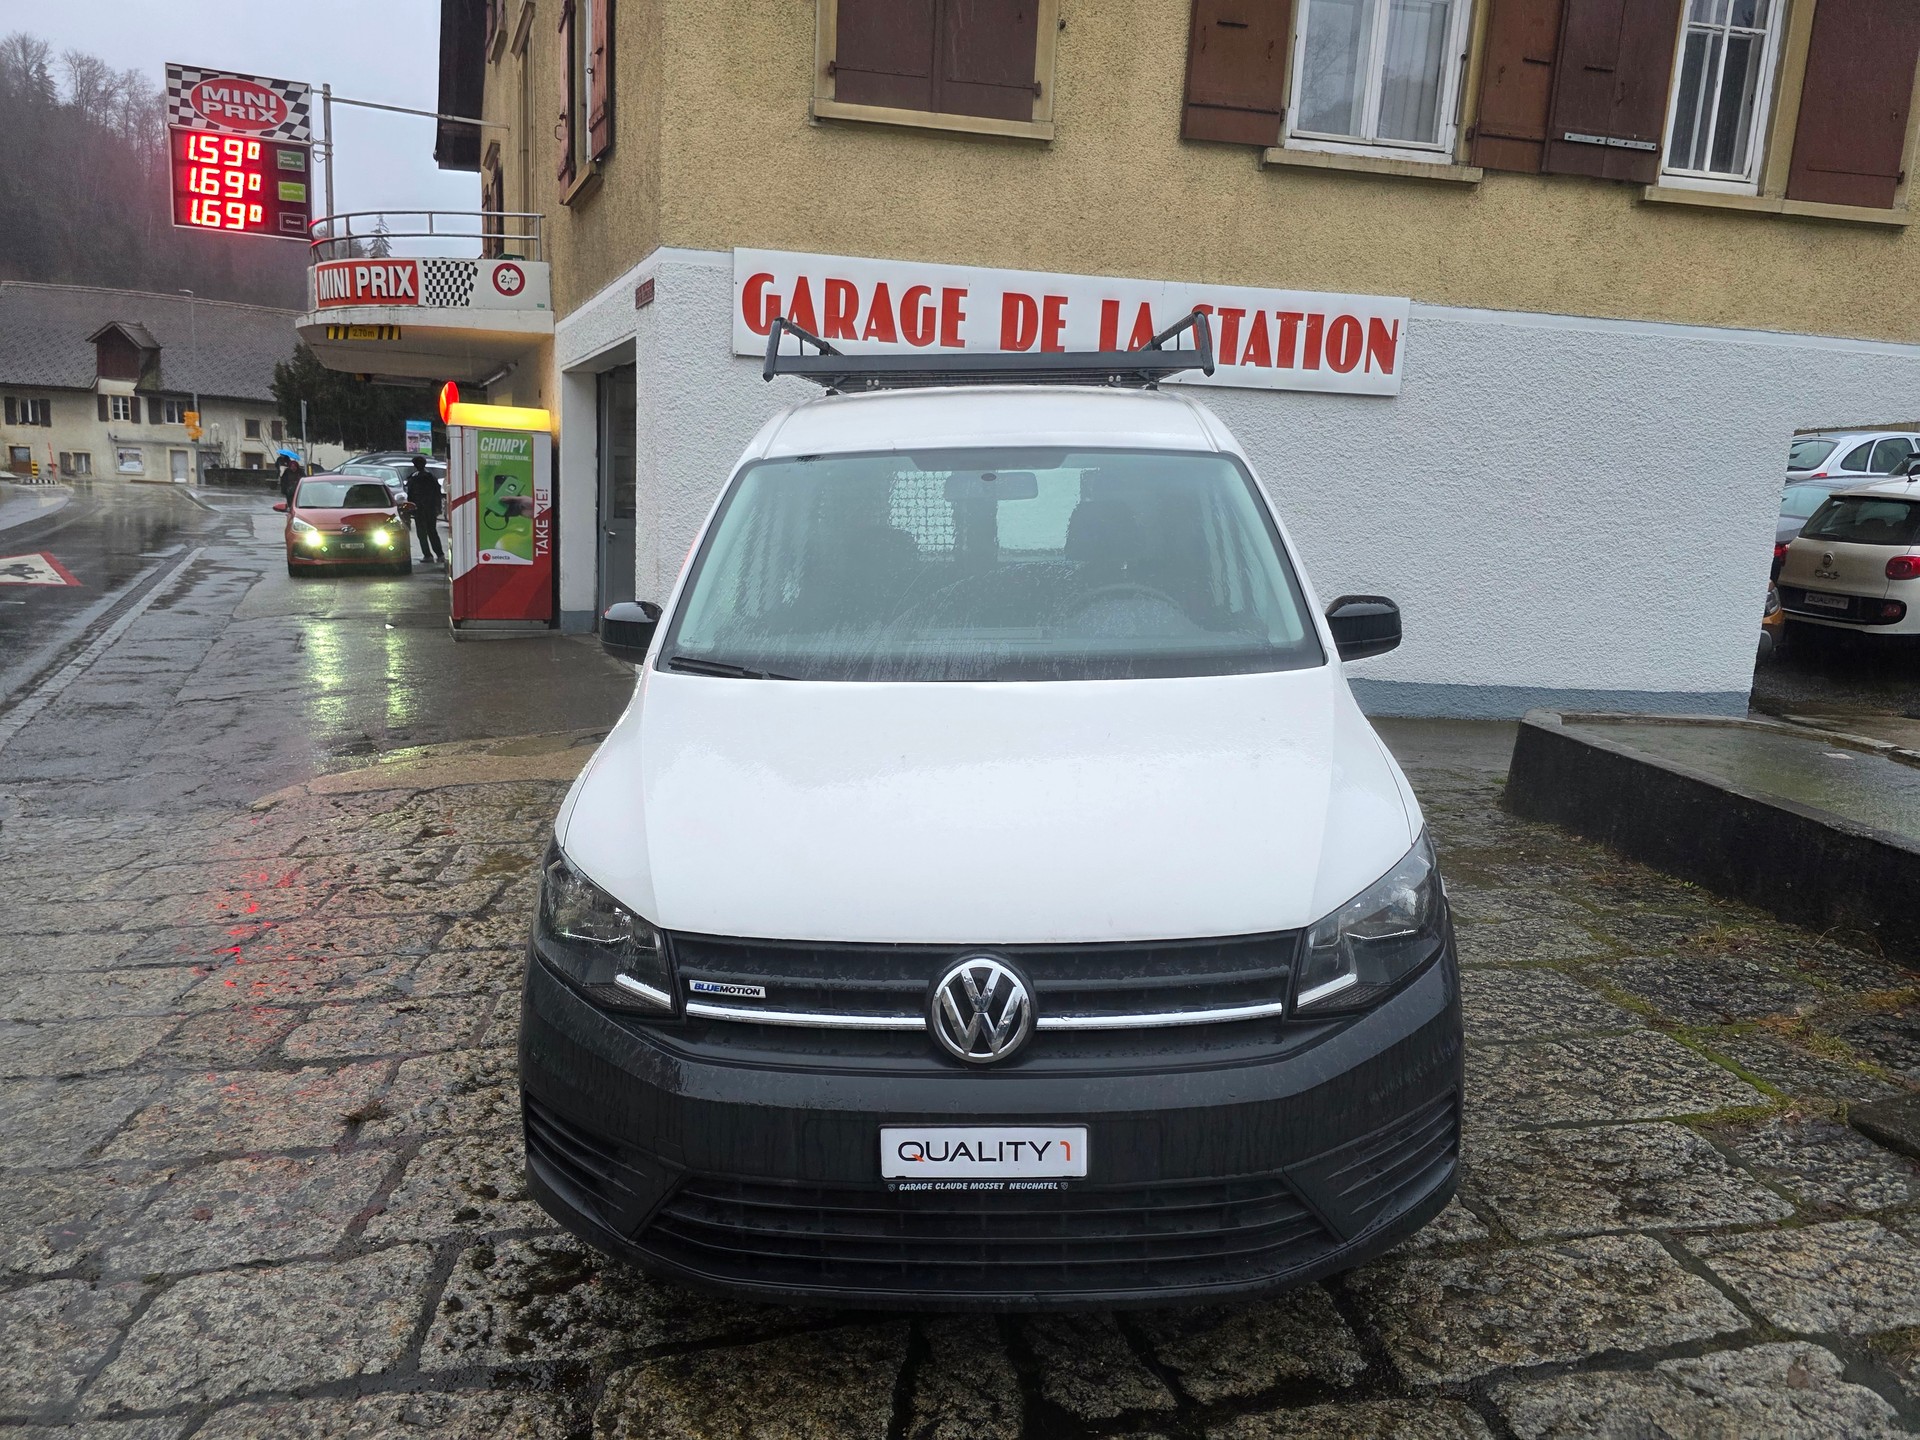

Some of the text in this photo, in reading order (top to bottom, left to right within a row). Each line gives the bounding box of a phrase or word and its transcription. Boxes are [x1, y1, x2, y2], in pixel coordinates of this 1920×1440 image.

[201, 85, 278, 109] MINI
[202, 101, 279, 124] PRIX
[318, 265, 416, 300] MINI PRIX
[742, 272, 968, 349] GARAGE
[1000, 292, 1068, 353] DE
[480, 437, 527, 454] CHIMPY
[536, 488, 549, 557] TAKE ME!
[693, 982, 761, 996] BLUEMOTION
[897, 1141, 1071, 1162] QUALITY 1
[898, 1182, 1059, 1191] GARAGE CLAUDE MOSSET NEUCHATEL
